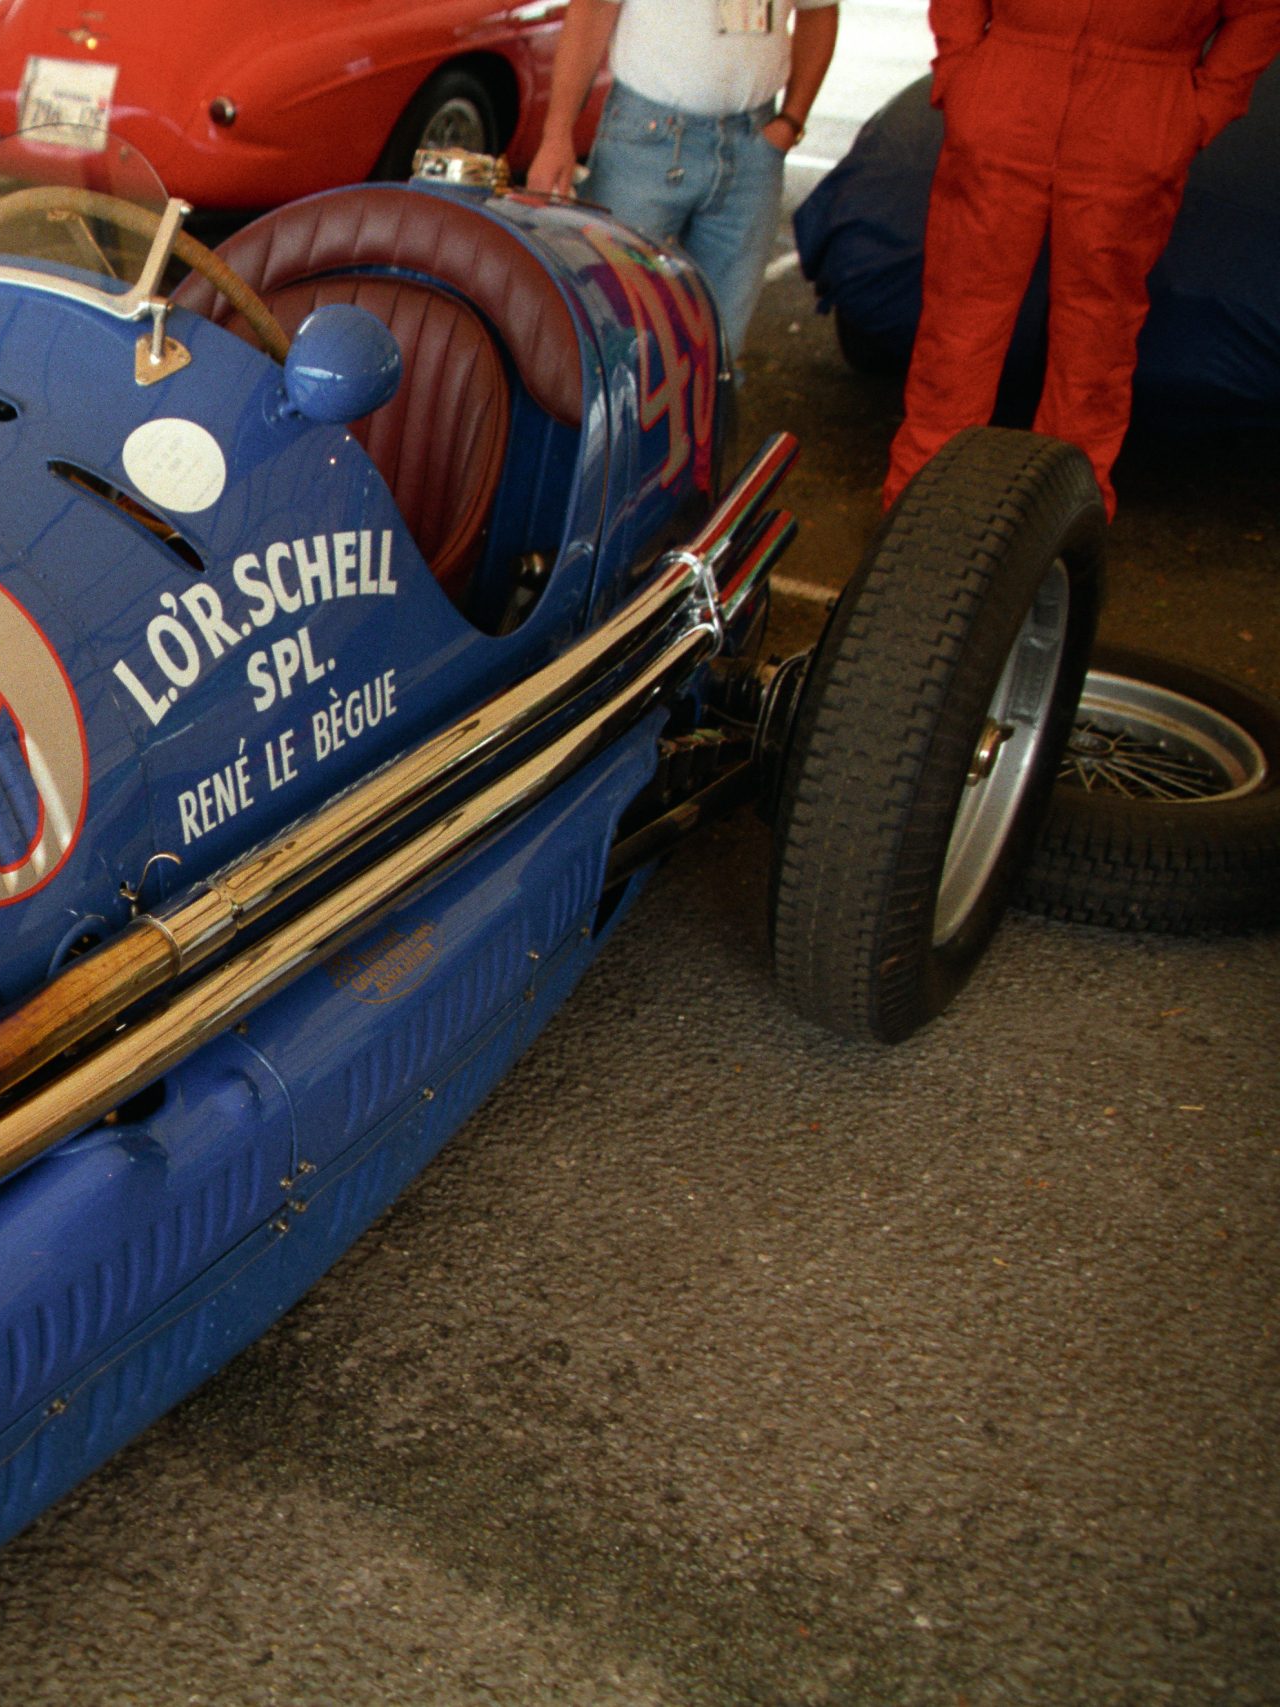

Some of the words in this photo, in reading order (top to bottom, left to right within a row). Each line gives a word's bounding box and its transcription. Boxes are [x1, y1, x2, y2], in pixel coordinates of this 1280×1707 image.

[246, 626, 336, 713] SPL.
[177, 737, 254, 846] RENÉ
[264, 728, 299, 792] LE
[312, 668, 398, 762] BÈGUE
